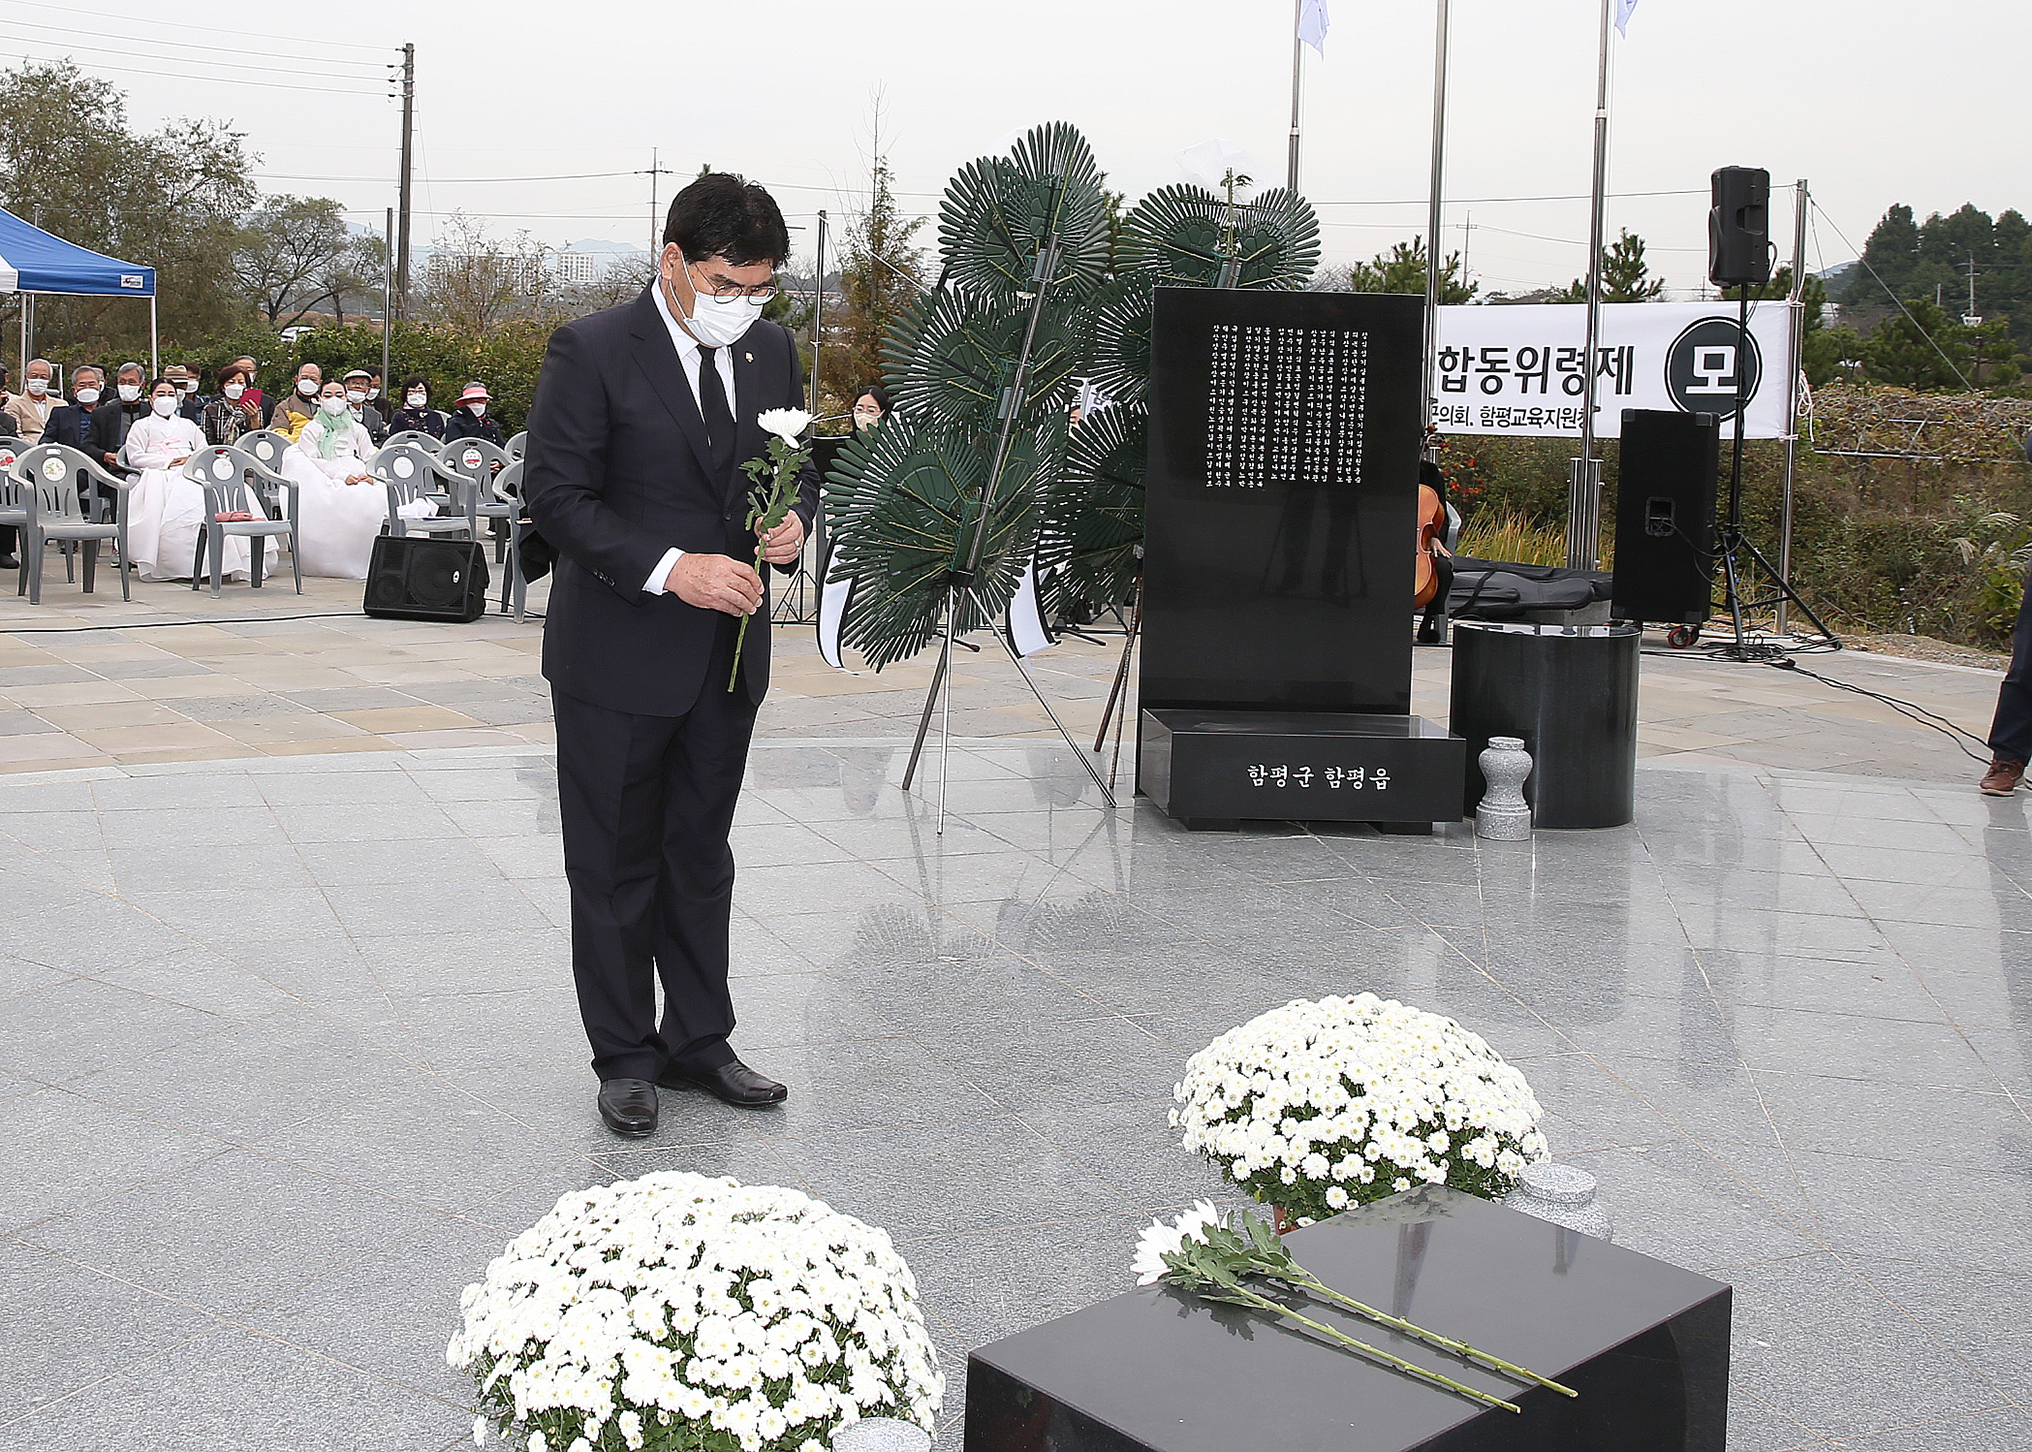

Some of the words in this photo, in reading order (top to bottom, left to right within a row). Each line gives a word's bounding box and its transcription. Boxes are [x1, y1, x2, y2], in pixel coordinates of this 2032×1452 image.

[1438, 346, 1635, 395] 합동위령제
[1685, 346, 1738, 394] 모
[1247, 764, 1315, 787] 함평군
[1324, 766, 1391, 790] 함평읍
